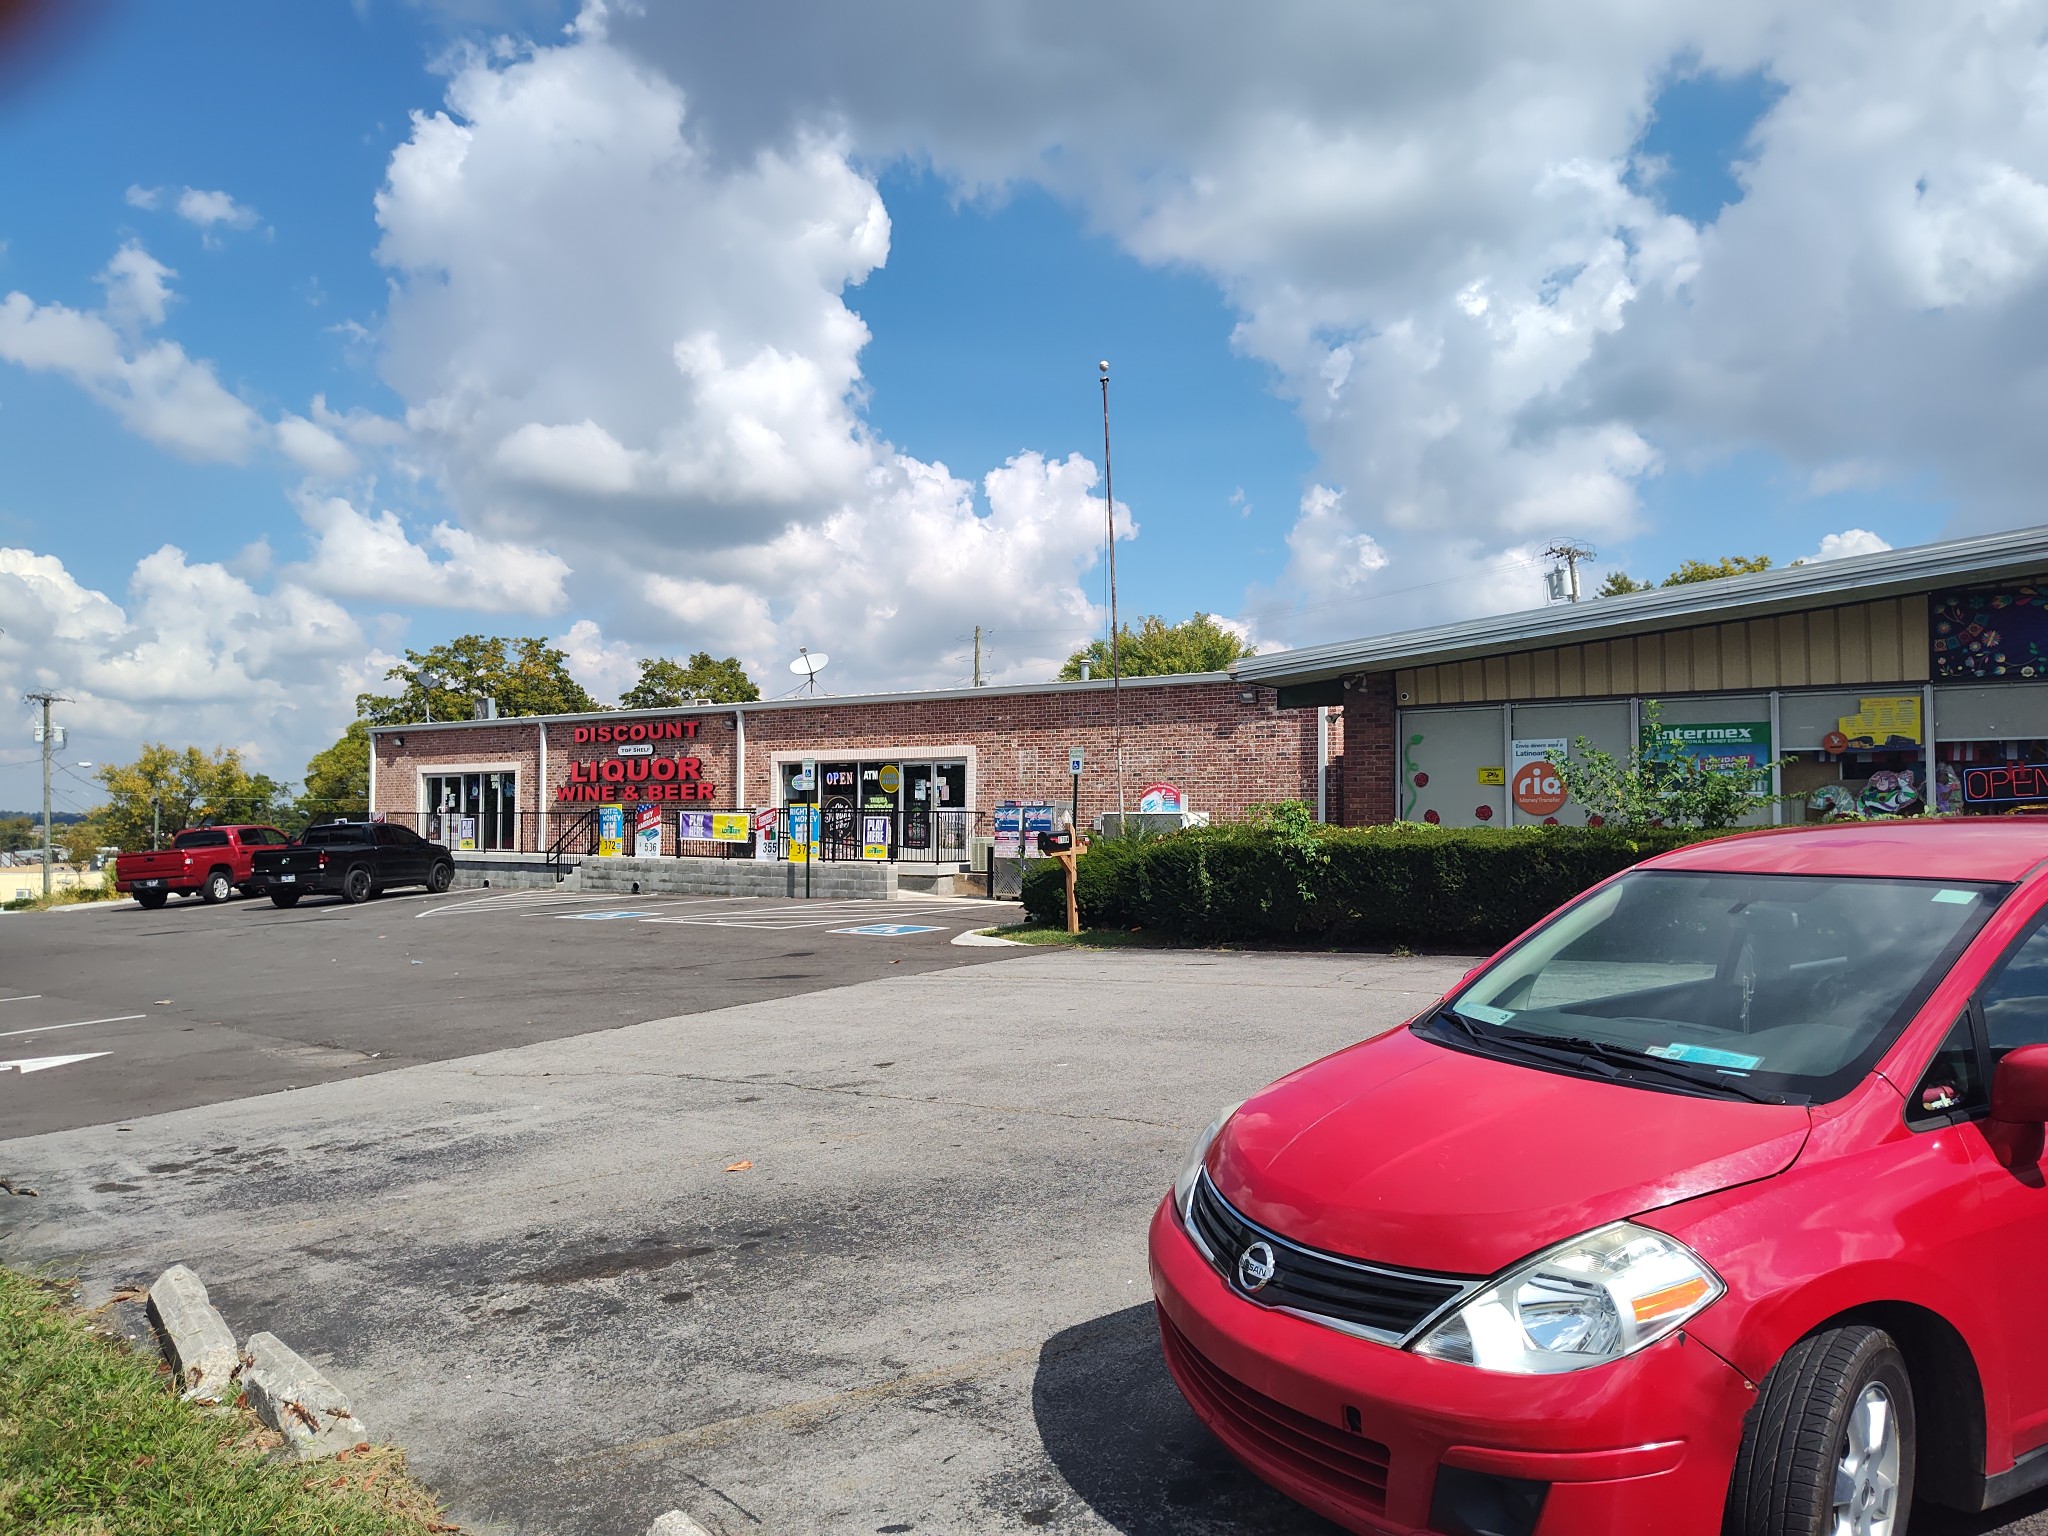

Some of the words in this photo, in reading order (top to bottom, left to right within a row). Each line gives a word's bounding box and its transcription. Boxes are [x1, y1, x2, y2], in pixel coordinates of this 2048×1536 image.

[574, 721, 700, 743] DISCOUNT
[570, 757, 702, 783] LIQUOR
[863, 770, 879, 780] ATM
[826, 772, 853, 785] OPEN
[1519, 768, 1561, 795] ria
[556, 785, 615, 801] WINE
[622, 785, 640, 801] &
[647, 783, 716, 801] BEER
[643, 810, 654, 820] BUY
[689, 815, 704, 826] PLAY
[867, 819, 885, 831] PLAY
[689, 826, 704, 837] HERE
[866, 831, 884, 843] HERE
[762, 842, 777, 853] 355
